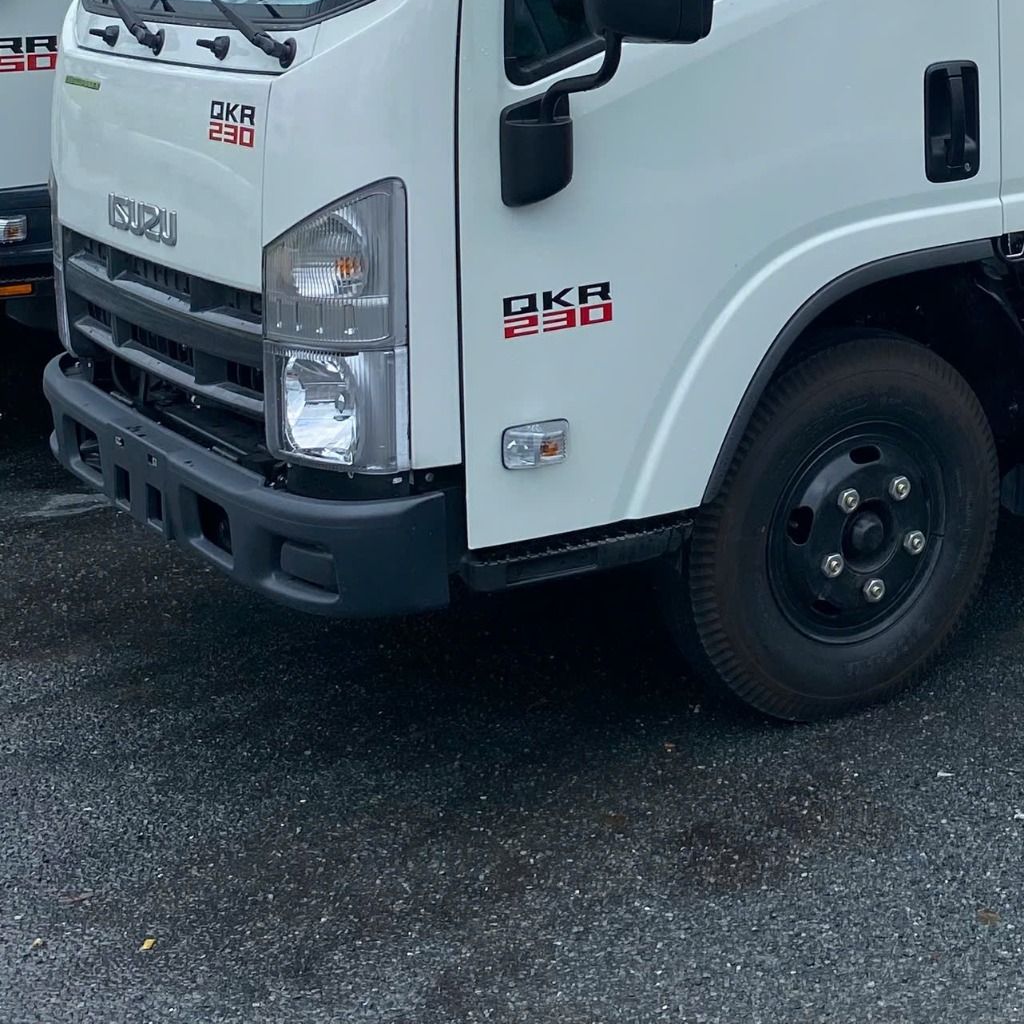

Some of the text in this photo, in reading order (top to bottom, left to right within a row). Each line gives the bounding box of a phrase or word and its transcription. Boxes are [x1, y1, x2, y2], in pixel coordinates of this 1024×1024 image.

[210, 100, 256, 126] QKR
[208, 121, 255, 148] 230
[108, 192, 177, 246] ISUZU
[503, 281, 612, 317] QKR
[503, 302, 613, 339] 230
